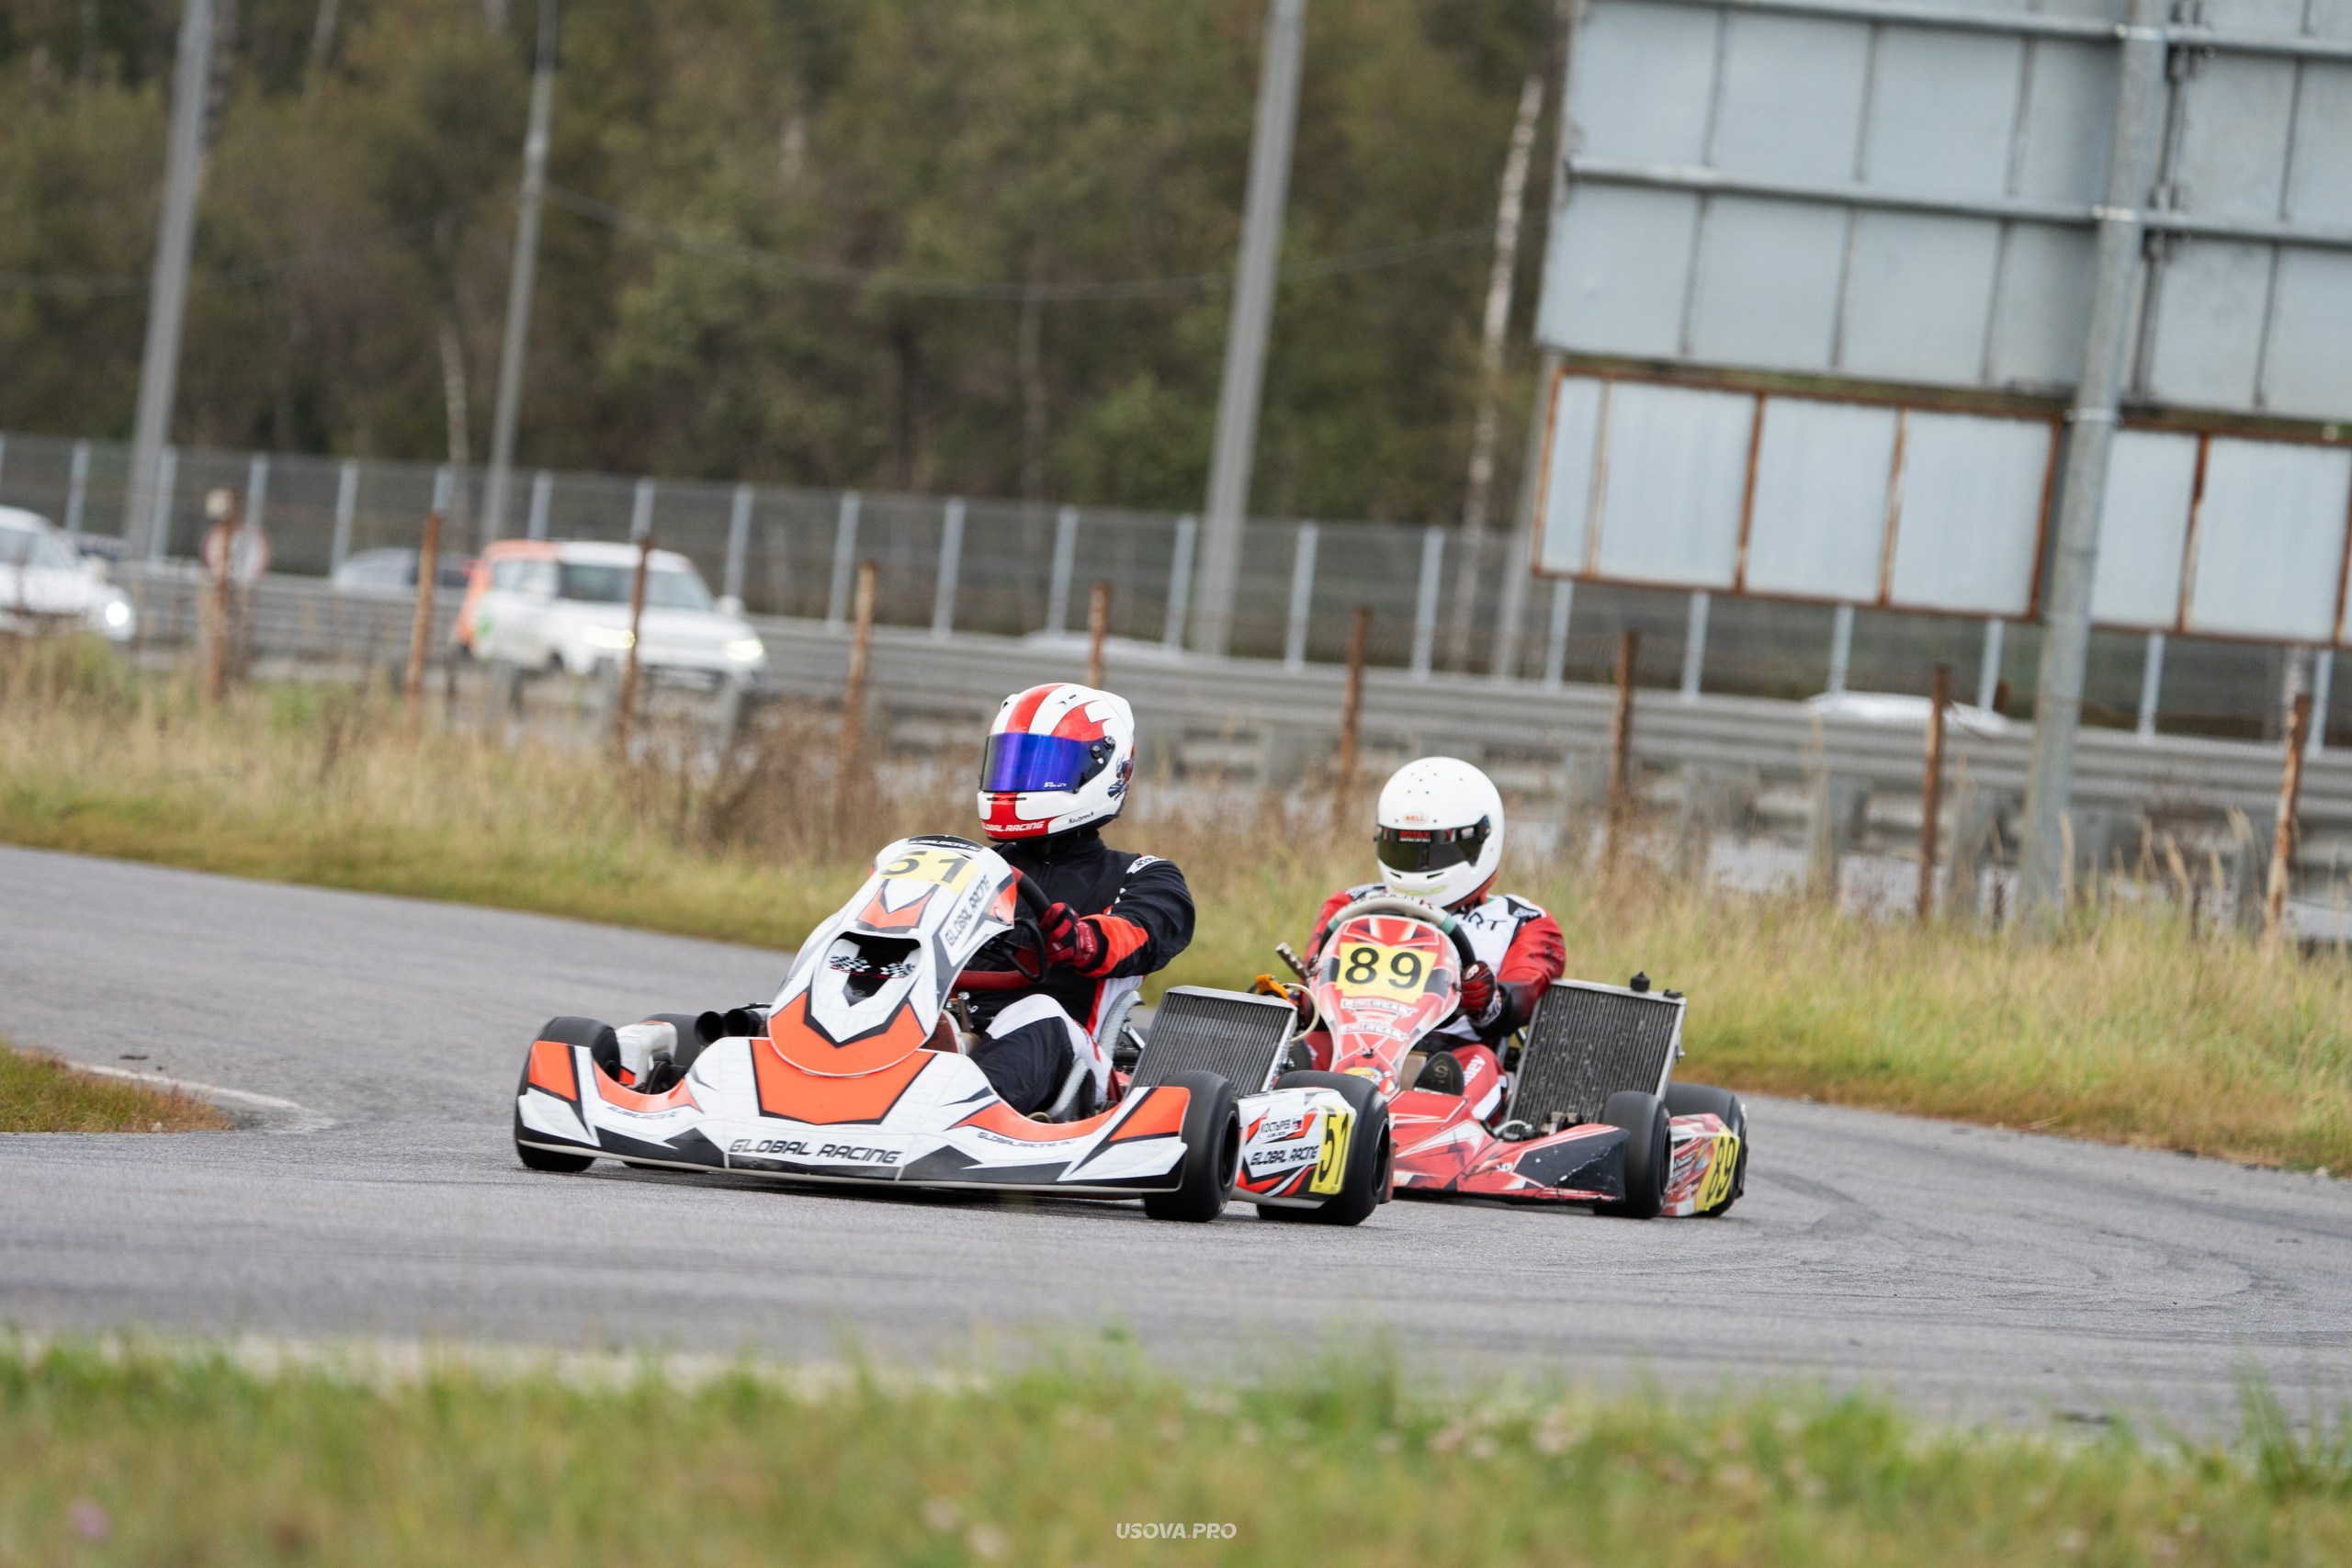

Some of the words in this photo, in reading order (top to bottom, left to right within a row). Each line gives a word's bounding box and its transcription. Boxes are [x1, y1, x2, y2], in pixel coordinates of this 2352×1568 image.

[1004, 820, 1046, 832] RACING
[881, 851, 969, 884] 51
[1345, 947, 1422, 989] 89
[729, 1139, 813, 1155] GLOBAL
[817, 1144, 904, 1164] RACING
[1250, 1150, 1286, 1166] GLOBAL
[1289, 1145, 1319, 1162] RACING
[1317, 1106, 1349, 1185] 51
[1706, 1136, 1736, 1202] 89
